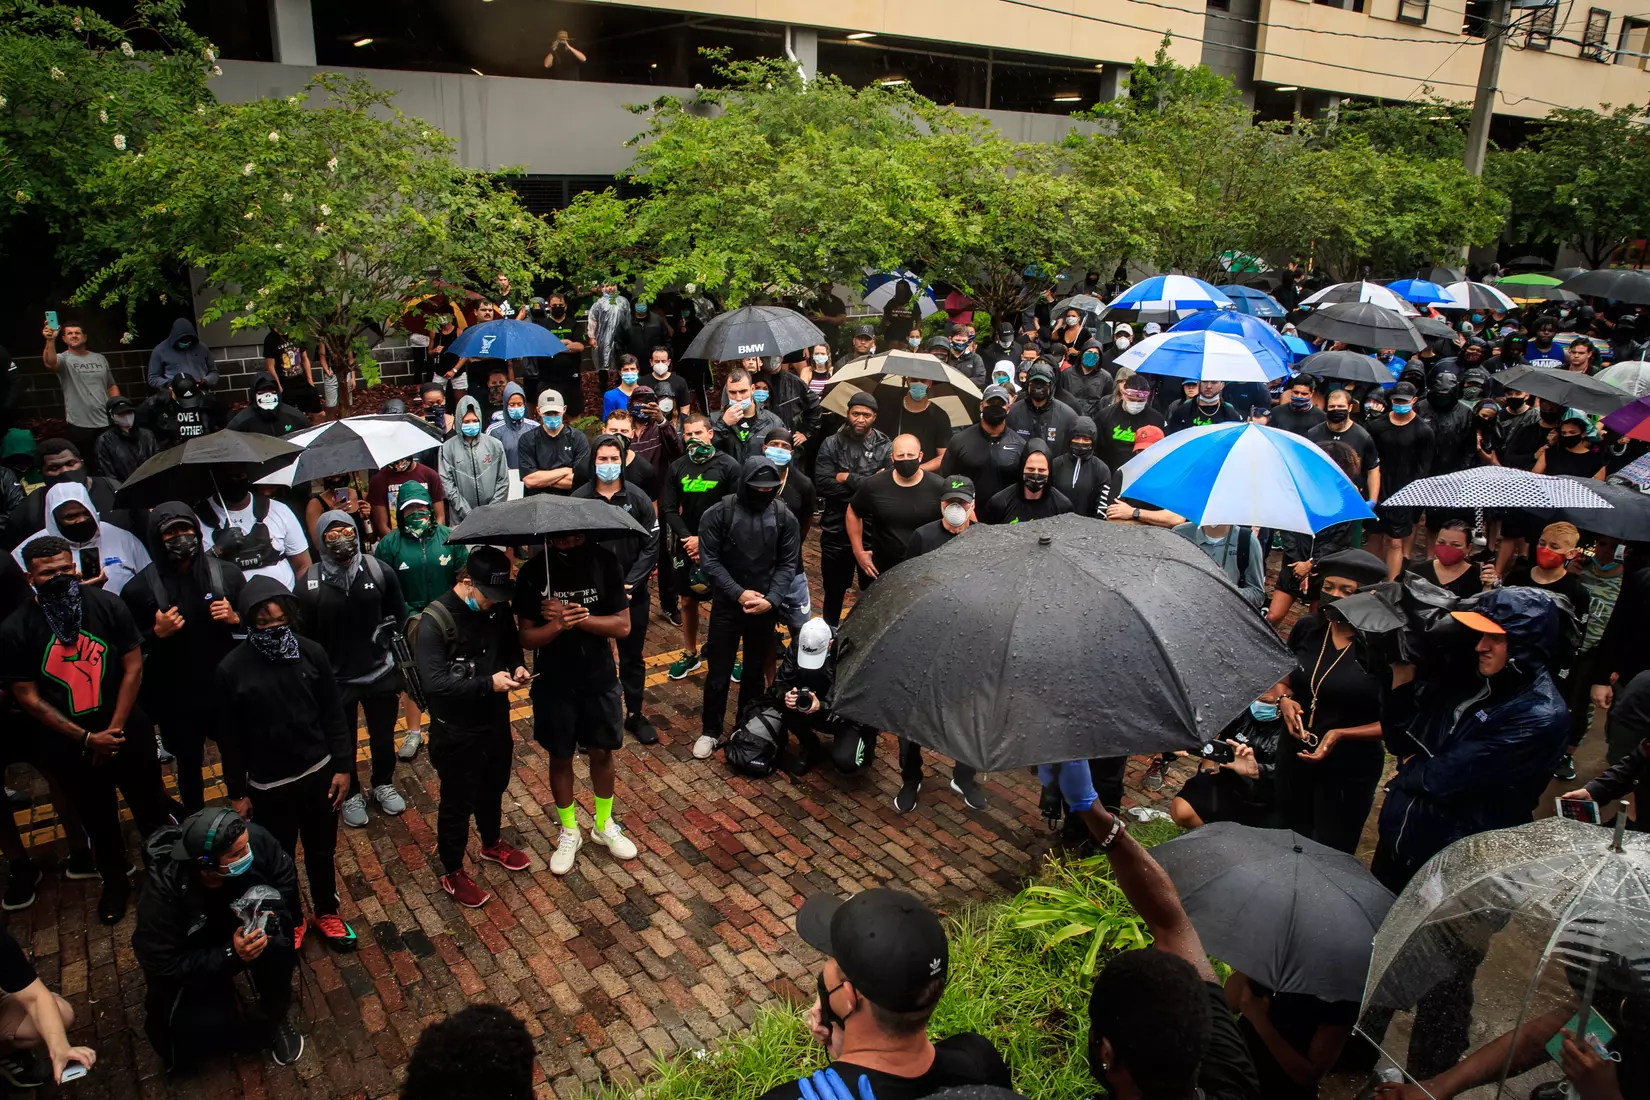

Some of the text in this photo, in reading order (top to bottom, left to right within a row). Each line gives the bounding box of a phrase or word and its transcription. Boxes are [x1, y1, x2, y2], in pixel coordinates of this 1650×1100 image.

[737, 343, 765, 354] BMW
[73, 362, 104, 370] FAITH
[177, 412, 195, 422] OVE
[681, 473, 719, 492] USF
